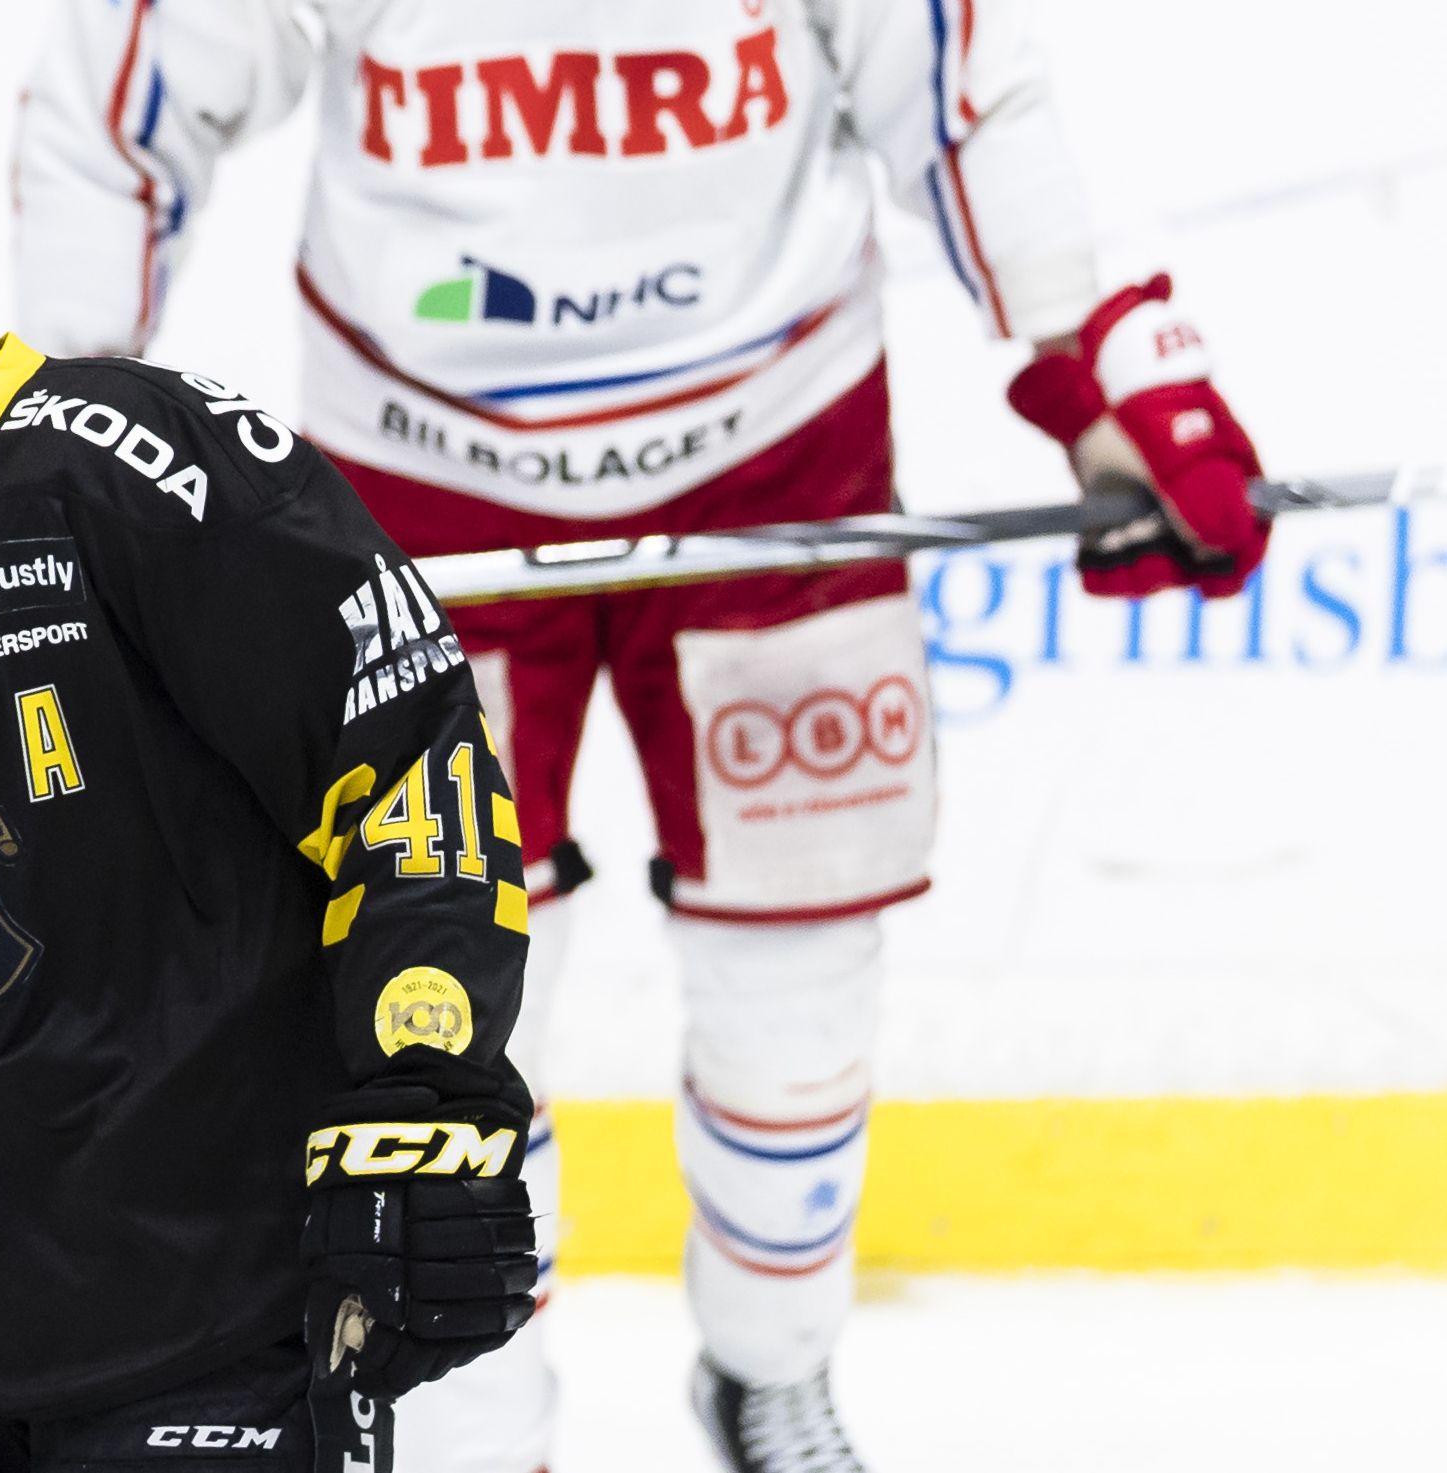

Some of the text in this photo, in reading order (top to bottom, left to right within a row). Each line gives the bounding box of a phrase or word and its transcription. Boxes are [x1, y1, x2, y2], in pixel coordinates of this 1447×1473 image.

[553, 263, 704, 326] NHC
[0, 388, 208, 522] ŠKODA
[14, 684, 86, 803] A
[360, 741, 490, 882] 41
[305, 1122, 519, 1187] CCM
[146, 1425, 283, 1449] CCM
